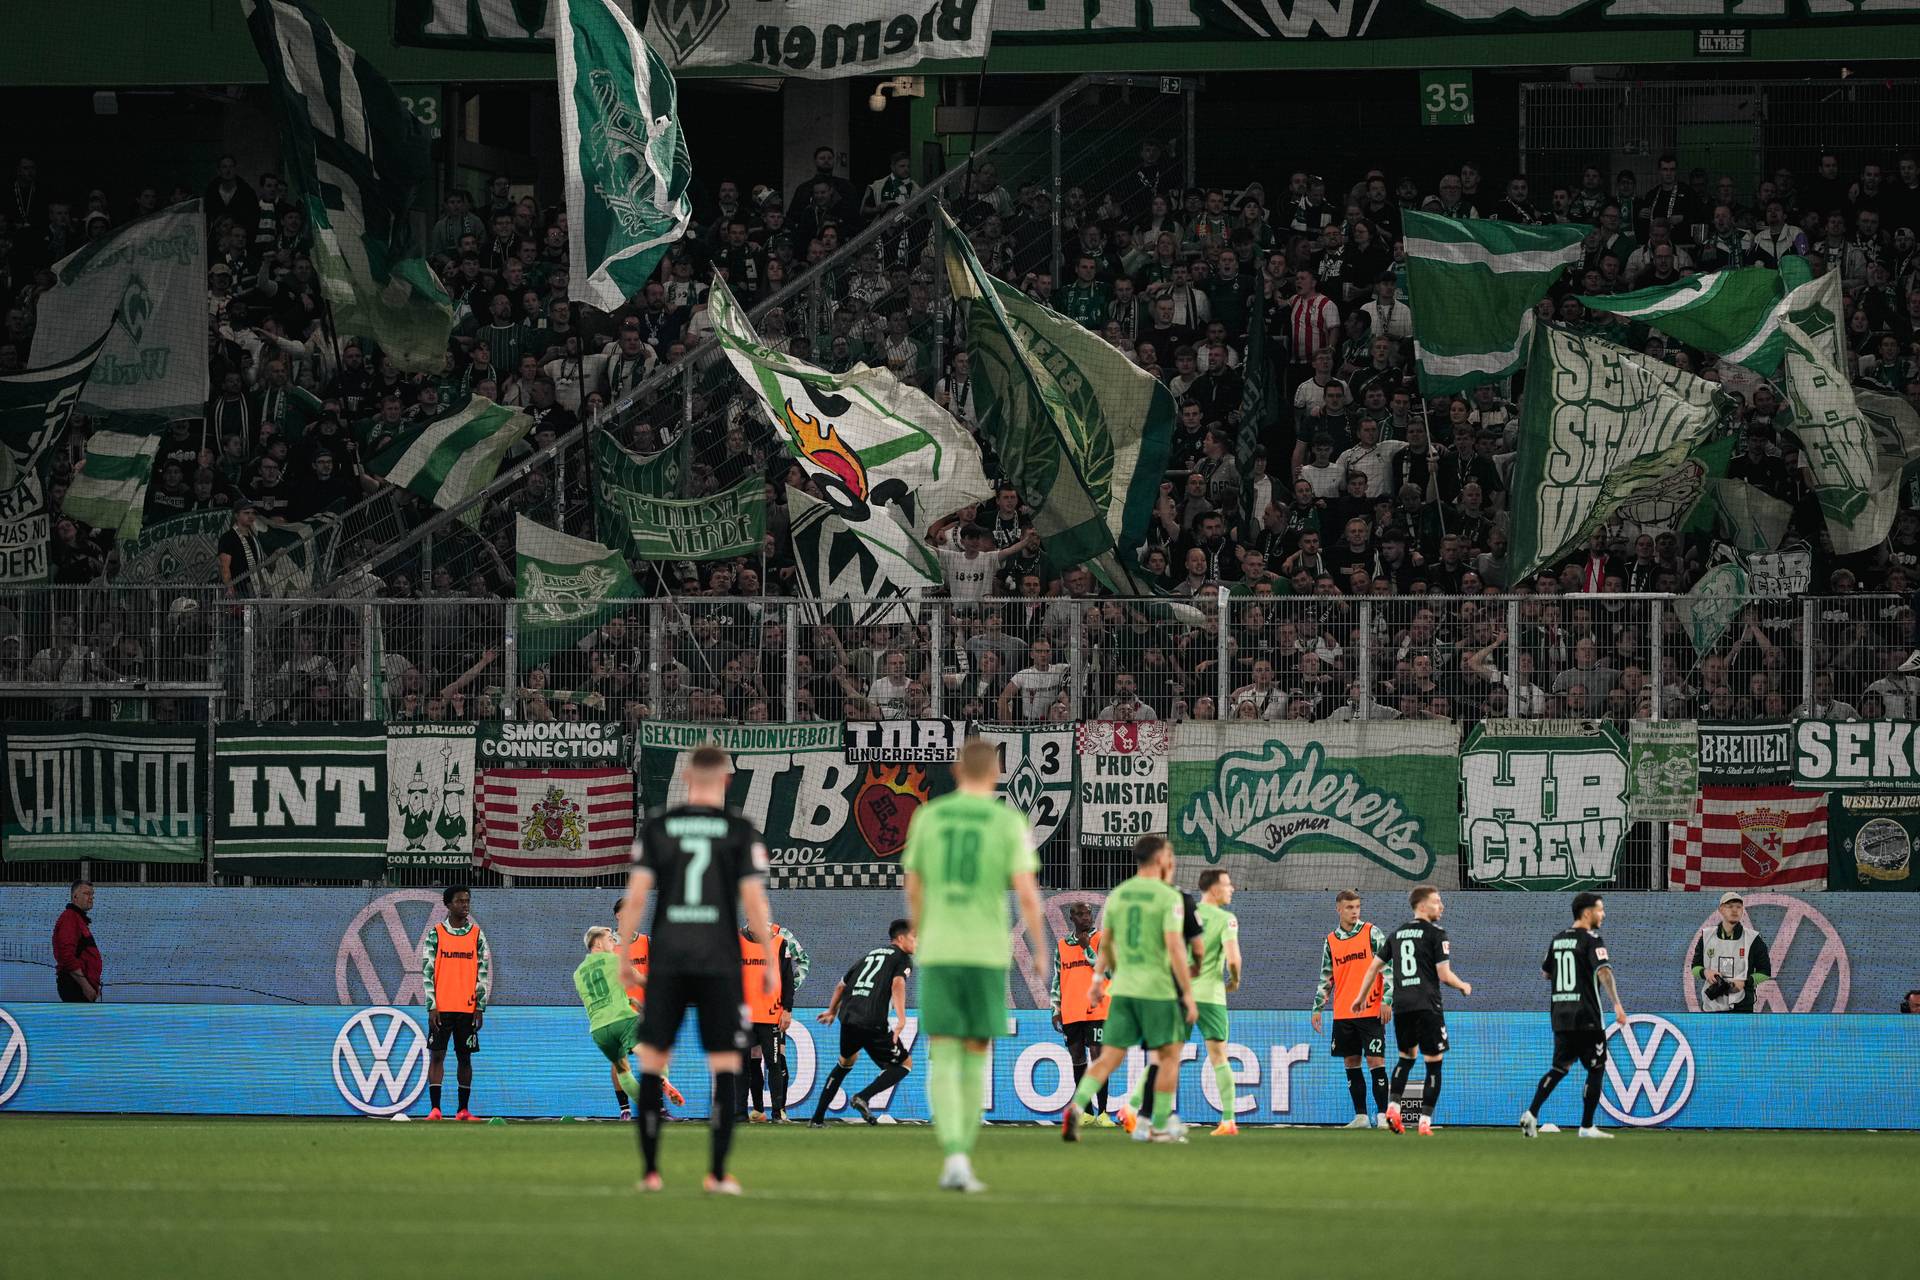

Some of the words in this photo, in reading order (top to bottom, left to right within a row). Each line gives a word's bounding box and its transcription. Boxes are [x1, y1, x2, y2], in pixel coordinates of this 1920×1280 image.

[1699, 37, 1744, 52] ULTRAS
[1425, 82, 1468, 112] 35
[33, 518, 47, 540] NO
[667, 514, 756, 555] VERDE
[387, 724, 411, 735] NON
[416, 724, 476, 735] PARLIAMO
[502, 722, 601, 741] SMOKING
[644, 725, 707, 745] SEKTION
[713, 725, 838, 750] STADIONVERBOT
[482, 739, 618, 758] CONNECTION
[848, 747, 959, 762] UNVERGESSE
[1040, 742, 1060, 775] 3
[1700, 733, 1789, 763] BREMEN
[1797, 721, 1920, 778] SEK
[1095, 755, 1132, 776] PRO
[229, 766, 377, 827] INT
[1082, 782, 1168, 804] SAMSTAG
[1461, 750, 1630, 822] HB
[1102, 811, 1153, 832] 15:30
[1081, 834, 1102, 847] OHNE
[1105, 835, 1121, 847] UNS
[1264, 817, 1330, 850] Bremen
[770, 847, 826, 865] 2002
[1469, 818, 1622, 880] CREW
[387, 857, 408, 866] CON
[412, 857, 426, 866] LA
[429, 856, 471, 866] POLIZIA
[680, 836, 713, 907] 7
[440, 949, 475, 960] hummel
[1062, 960, 1091, 970] humme
[1335, 949, 1367, 967] hummel
[1401, 940, 1418, 977] 8
[853, 954, 886, 990] 22
[1554, 950, 1577, 992] 10
[1092, 1027, 1104, 1042] 19
[1368, 1039, 1384, 1054] 42
